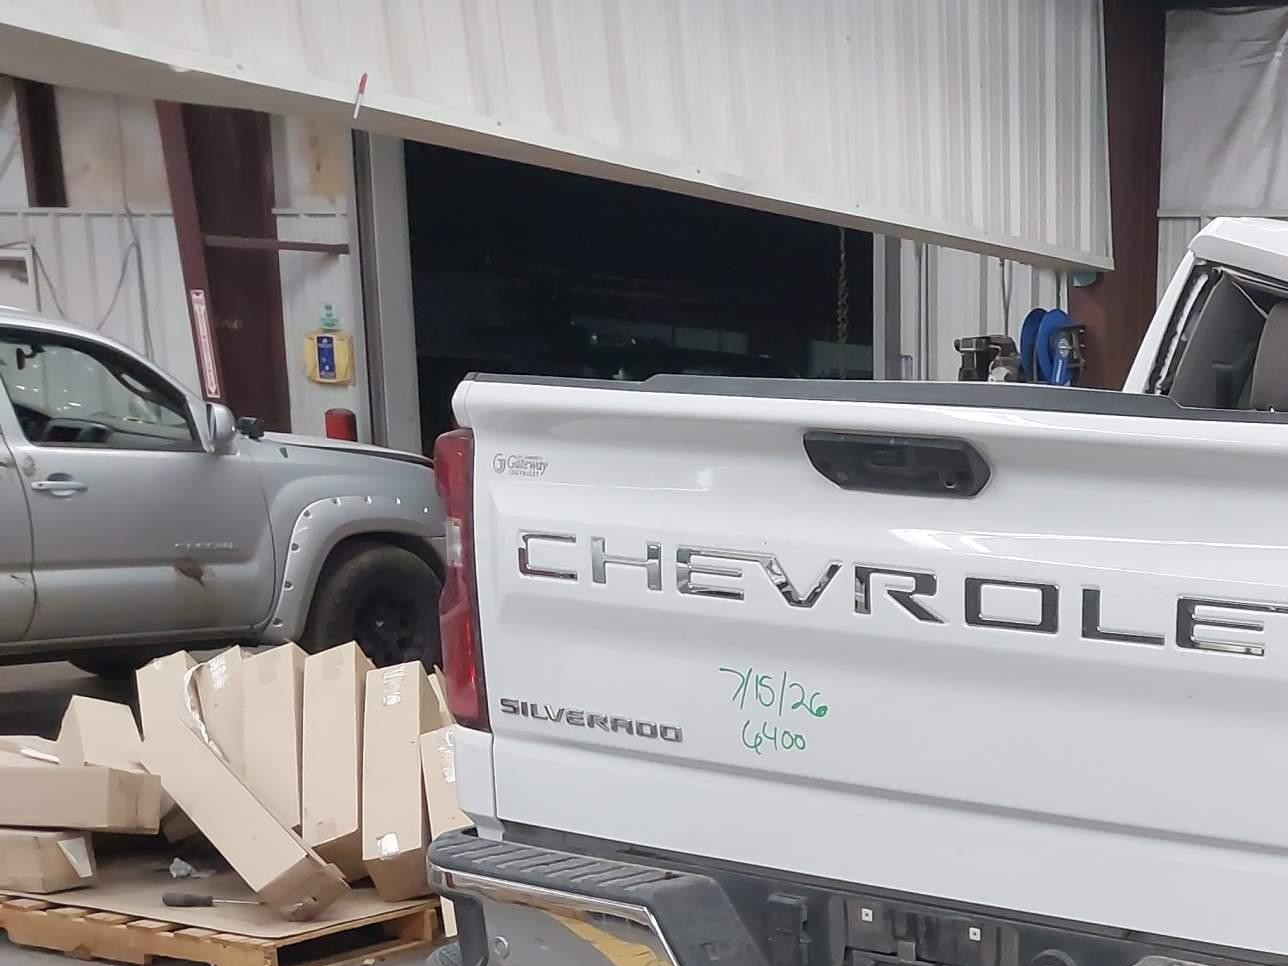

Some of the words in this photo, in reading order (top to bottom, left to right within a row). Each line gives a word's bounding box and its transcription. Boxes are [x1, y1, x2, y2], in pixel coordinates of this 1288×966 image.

[719, 667, 828, 718] 7/15/26
[500, 698, 683, 743] SILVERADO
[742, 719, 806, 755] 6400
